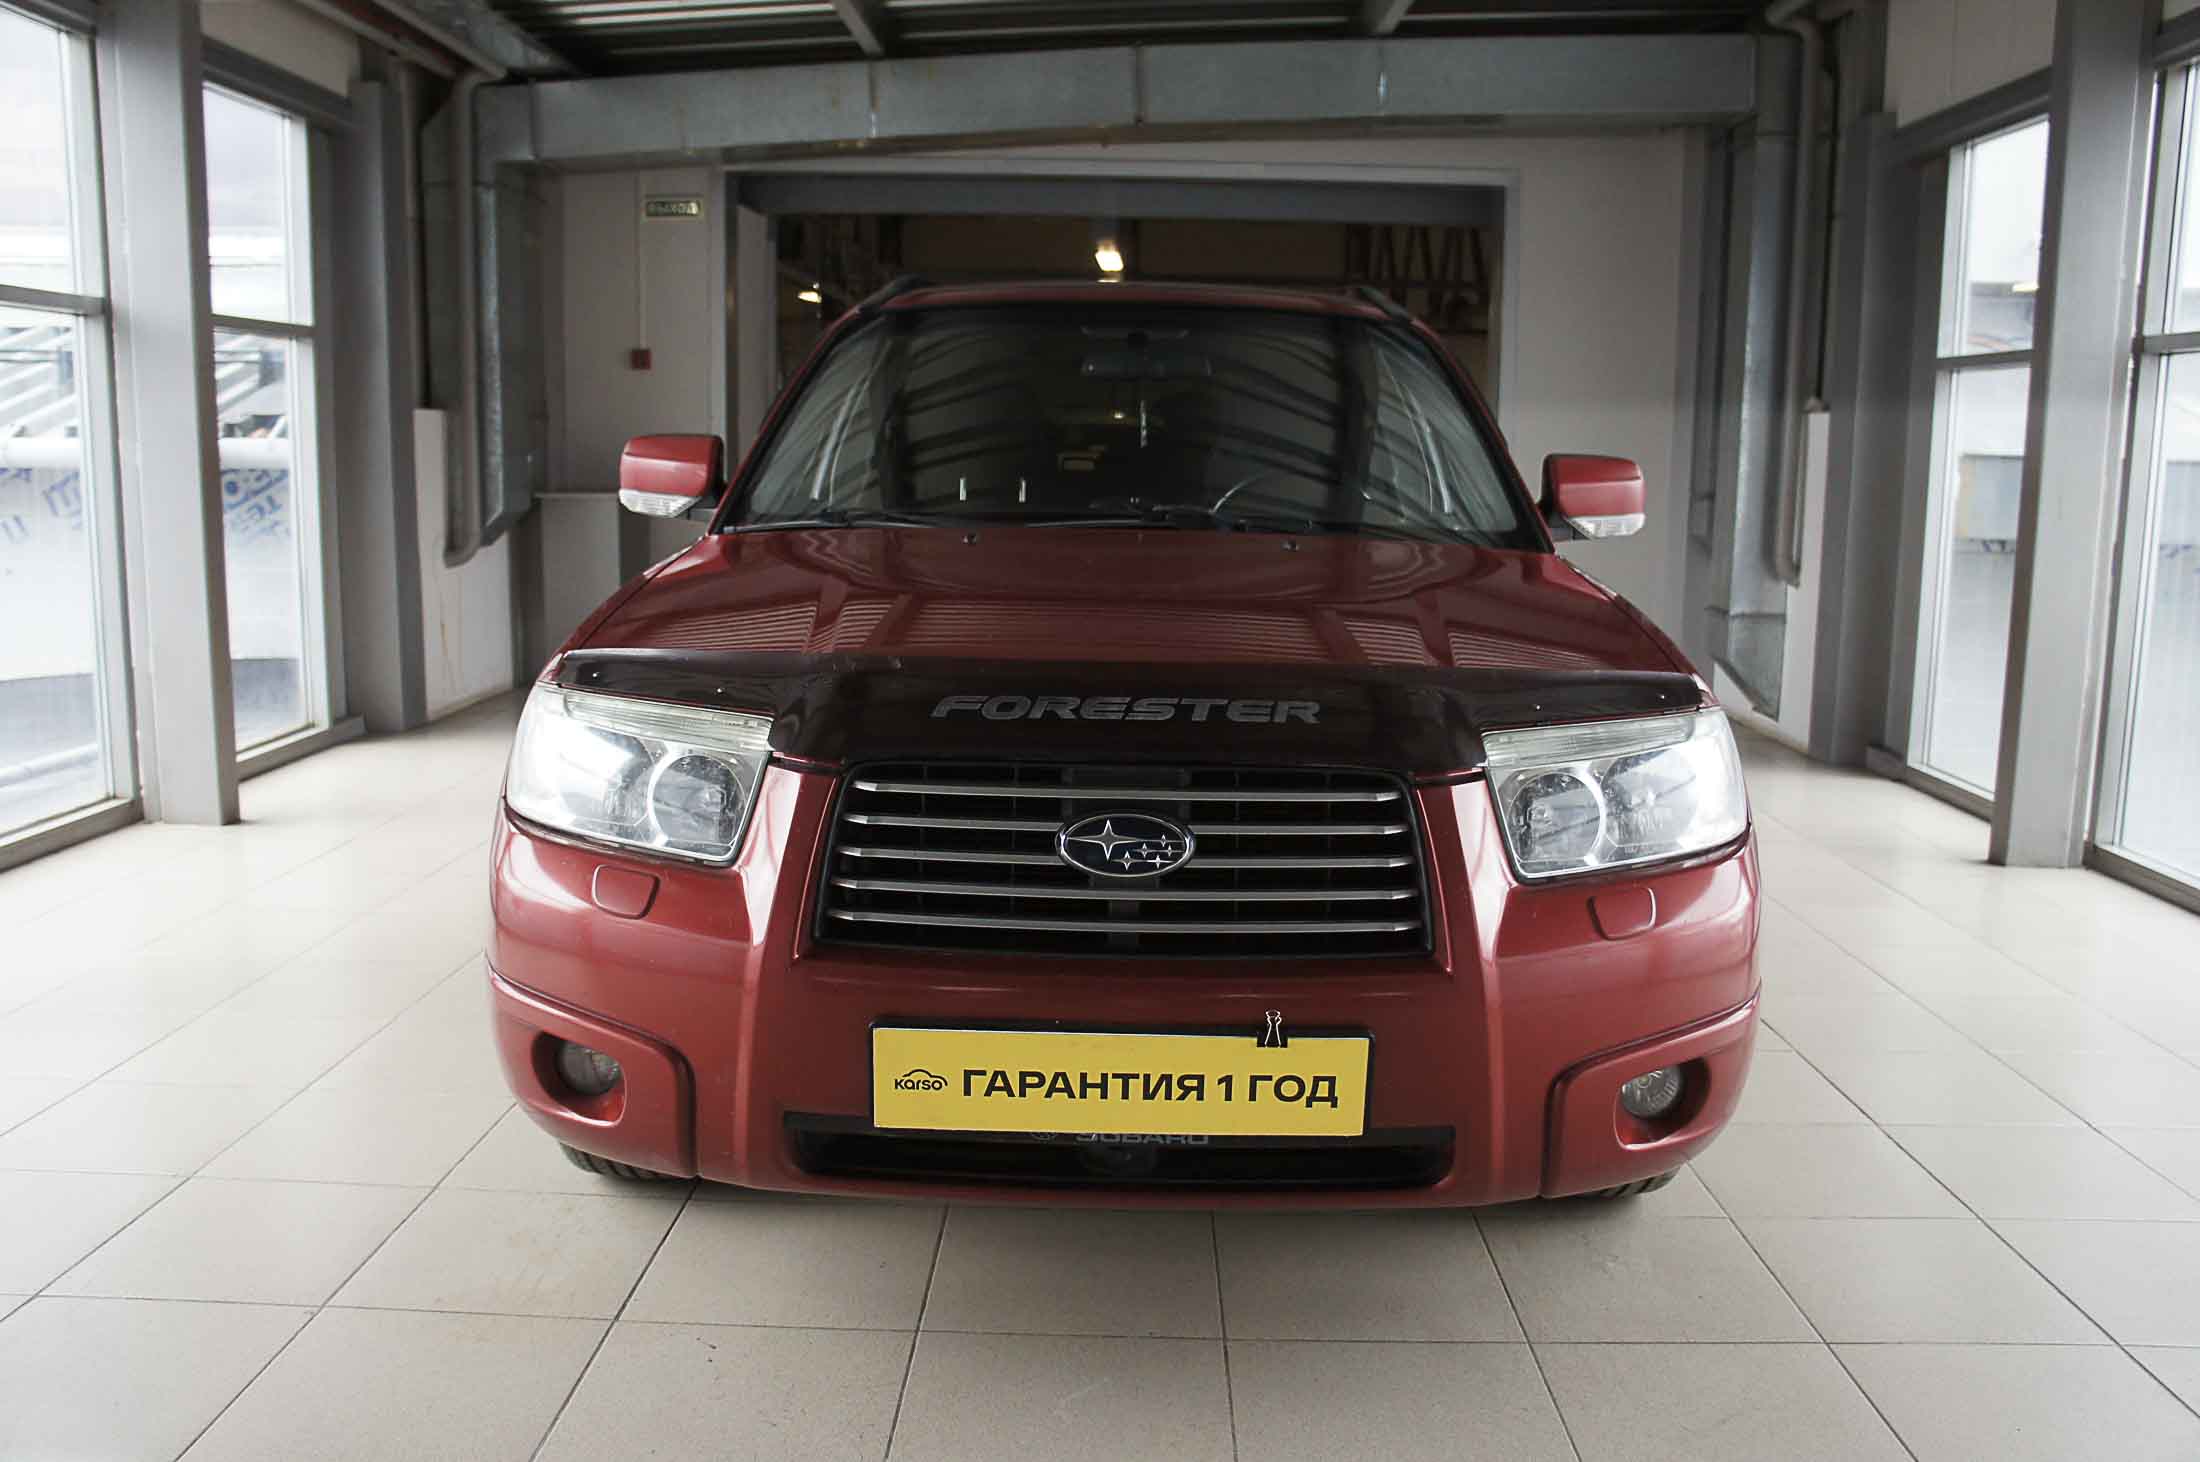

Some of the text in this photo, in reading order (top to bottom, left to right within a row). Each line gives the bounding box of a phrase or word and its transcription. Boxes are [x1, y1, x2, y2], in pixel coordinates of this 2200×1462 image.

[930, 695, 1320, 723] FORESTER
[963, 1069, 1338, 1108] ГАРАНТИЯ 1 ГОД
